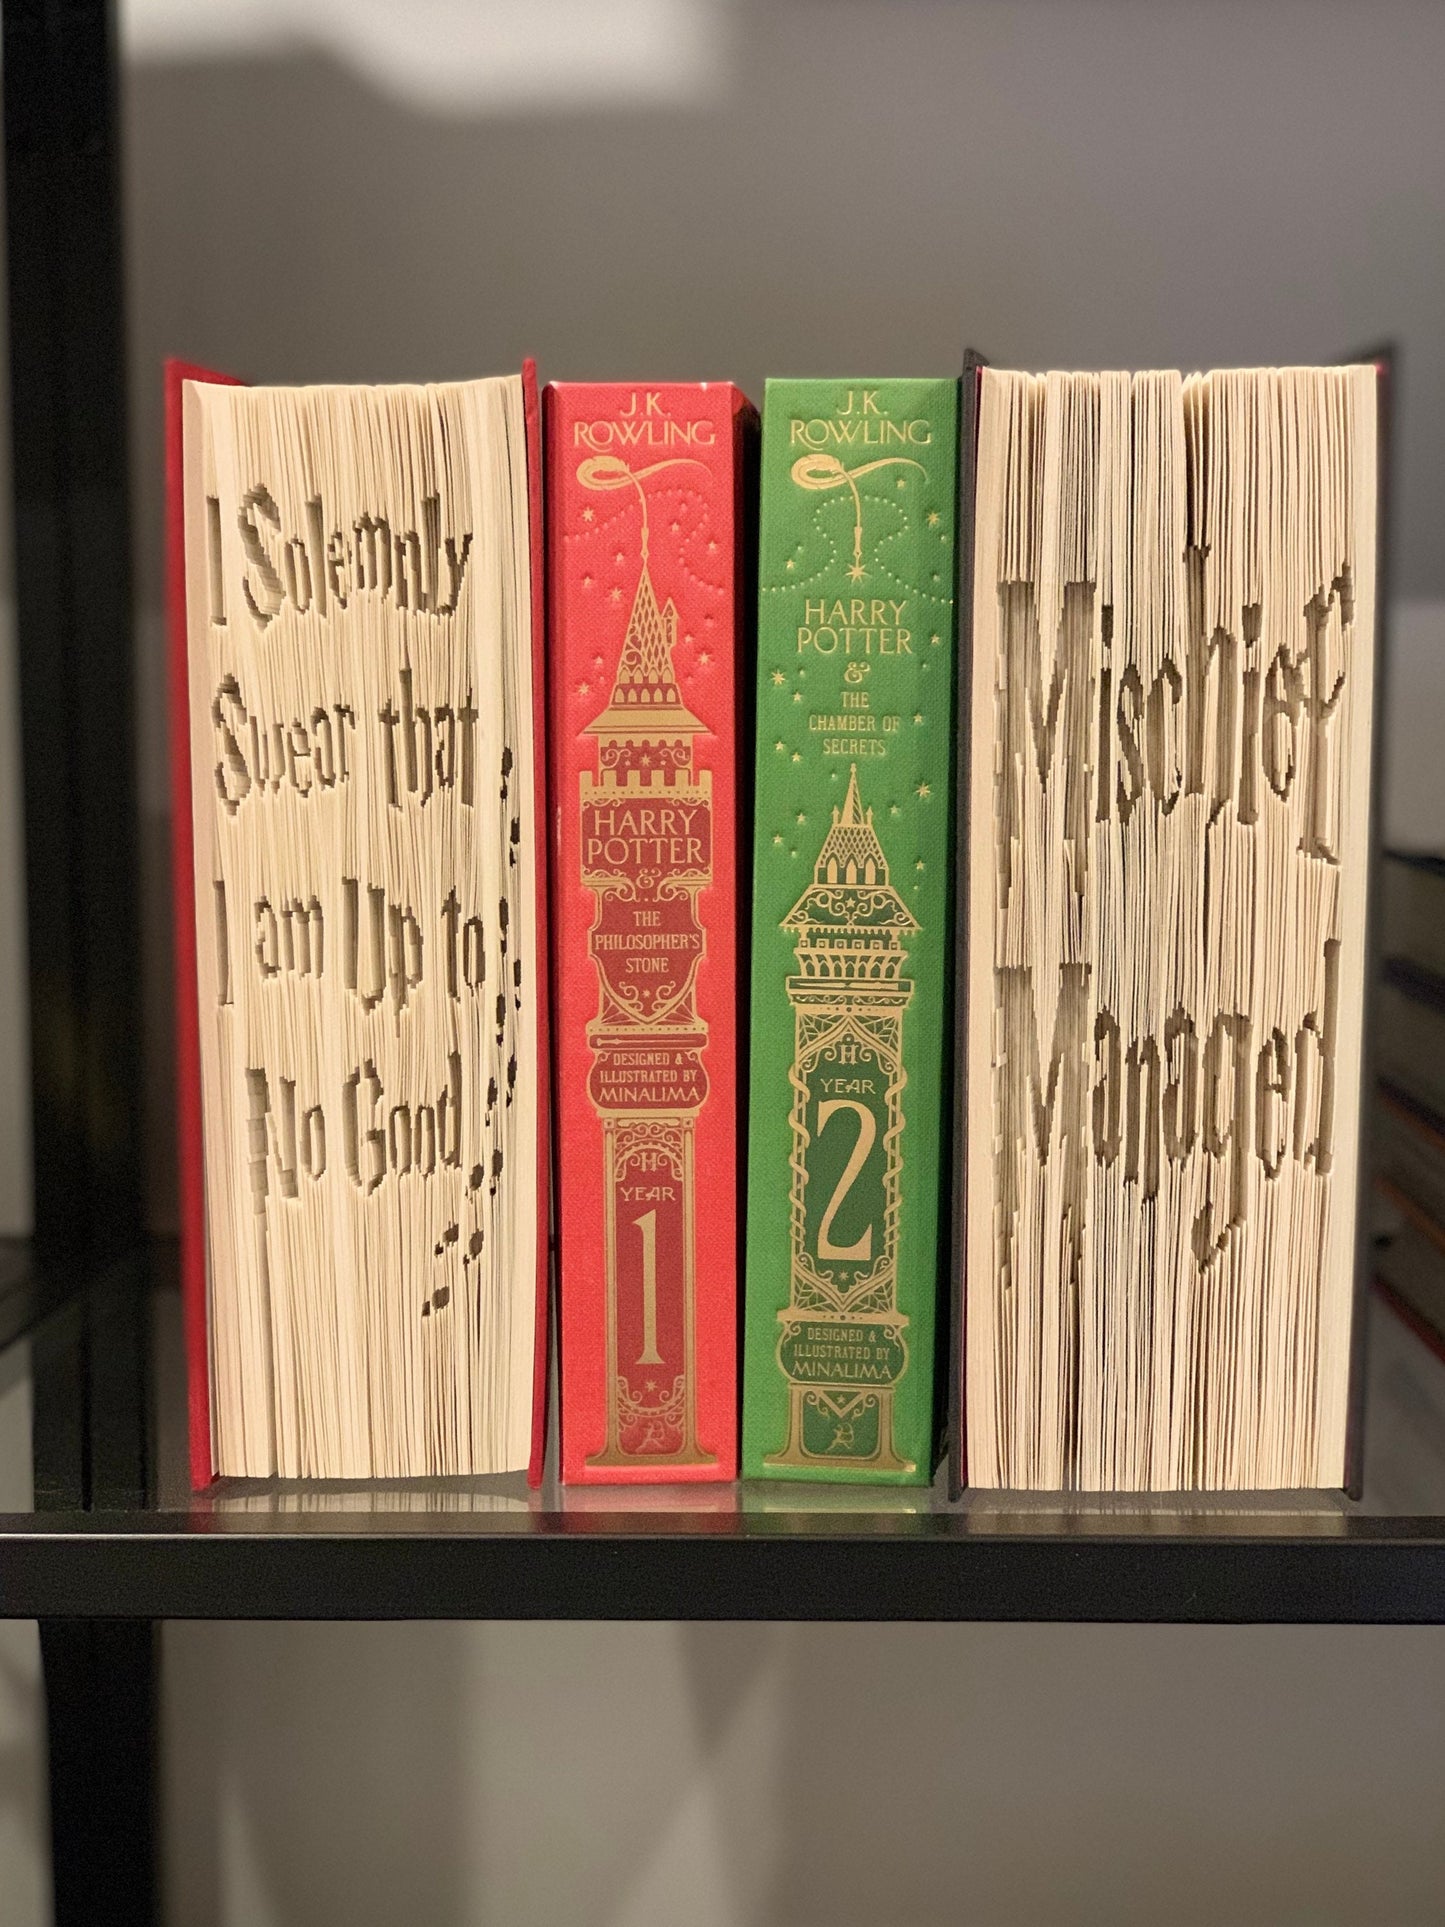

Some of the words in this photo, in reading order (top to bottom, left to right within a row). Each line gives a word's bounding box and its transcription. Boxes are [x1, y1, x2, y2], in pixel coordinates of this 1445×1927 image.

[620, 392, 672, 417] J.K.
[836, 390, 889, 415] J.K.
[573, 420, 716, 452] ROWLING
[790, 419, 932, 451] ROWLING
[803, 598, 908, 626] HARRY
[796, 626, 914, 654] POTTER
[843, 661, 871, 684] &
[839, 691, 870, 708] THE
[808, 714, 876, 732] CHAMBER
[882, 715, 902, 732] OF
[211, 673, 358, 816] Swear
[377, 668, 479, 812] that
[822, 738, 887, 755] SECRETS
[593, 809, 699, 836] HARRY
[586, 837, 705, 865] POTTER
[636, 868, 662, 889] &
[632, 911, 662, 927] THE
[254, 896, 324, 980] am
[341, 876, 424, 1022] Up
[440, 886, 486, 1003] to
[594, 933, 701, 951] PHILOSOPHER'S
[625, 957, 670, 974] STONE
[612, 1052, 670, 1066] DESIGNED
[674, 1052, 684, 1066] &
[600, 1070, 678, 1084] ILLUSTRATED
[683, 1069, 698, 1083] BY
[820, 1078, 877, 1095] YEAR
[600, 1087, 701, 1102] MINALIMA
[245, 1067, 327, 1216] No
[341, 1051, 463, 1196] Good
[816, 1099, 877, 1261] 2
[620, 1186, 676, 1202] YEAR
[631, 1208, 666, 1365] 1
[807, 1327, 863, 1343] DESIGNED
[868, 1329, 878, 1343] &
[794, 1343, 871, 1360] ILLUSTRATED
[876, 1347, 890, 1360] BY
[792, 1360, 893, 1380] MINALIMA
